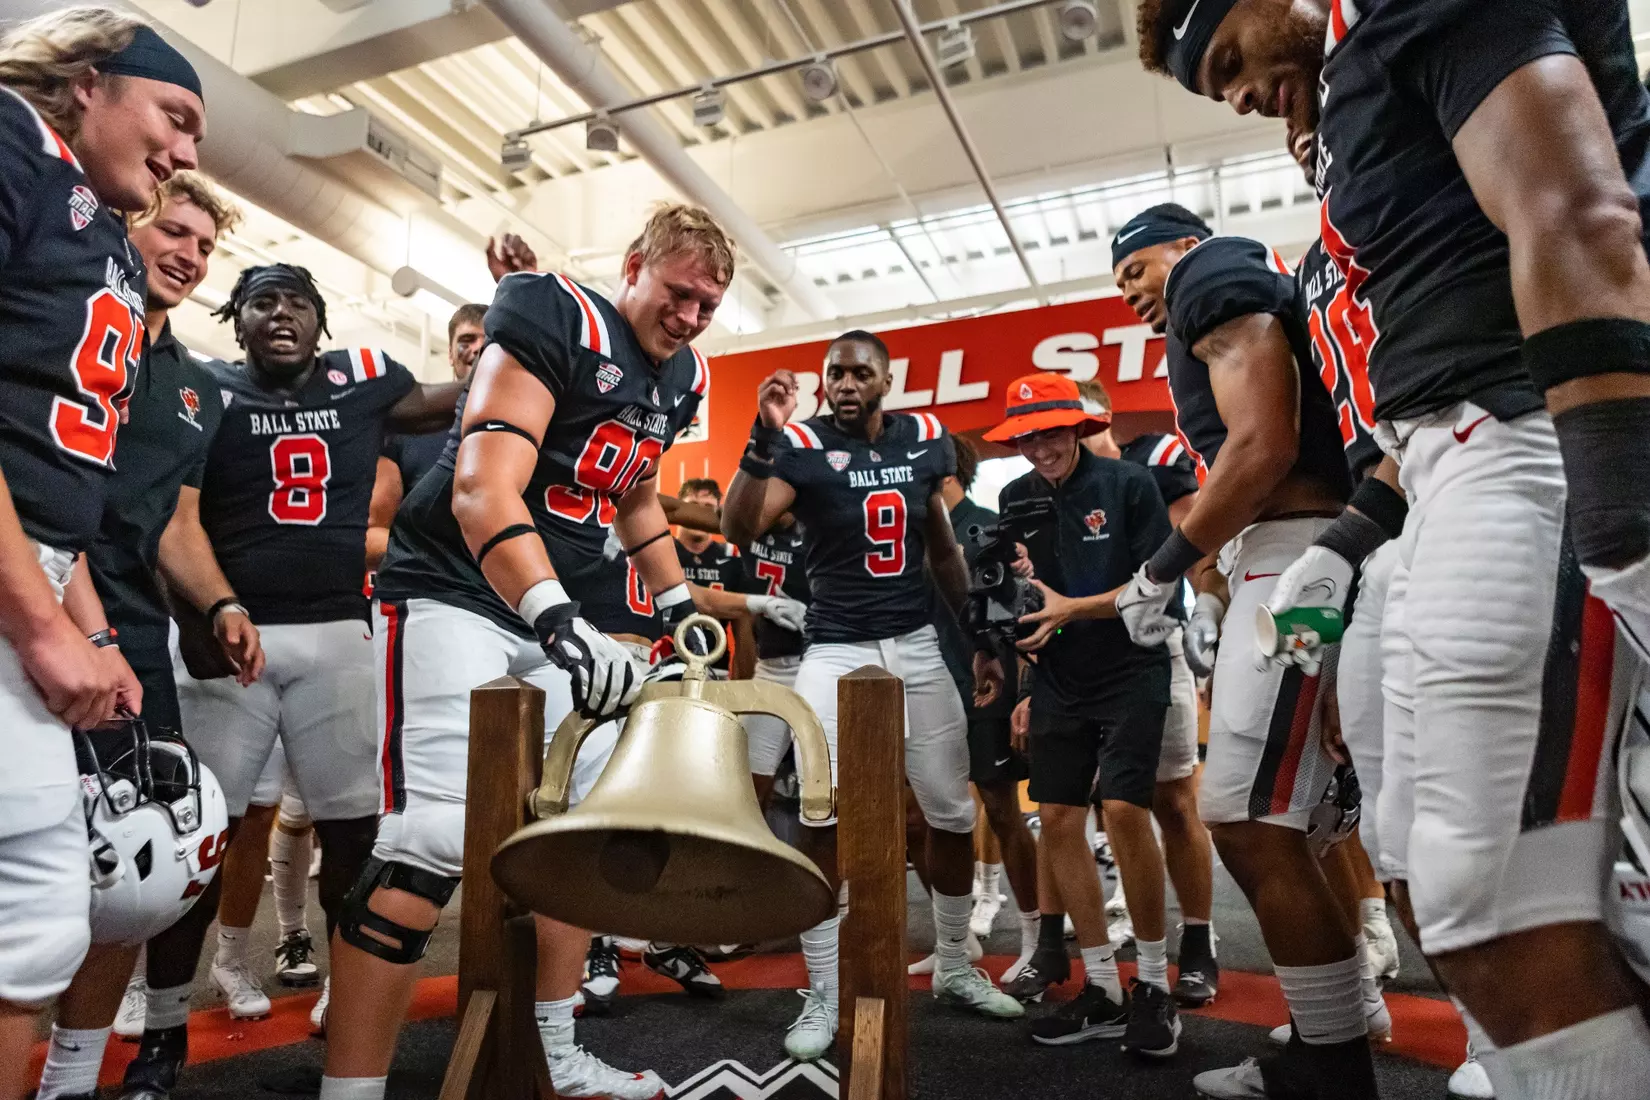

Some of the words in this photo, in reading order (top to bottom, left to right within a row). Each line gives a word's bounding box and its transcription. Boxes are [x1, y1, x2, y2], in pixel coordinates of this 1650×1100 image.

[68, 194, 97, 222] MAC
[596, 368, 621, 387] MAC
[789, 348, 990, 424] BLL
[250, 413, 292, 435] BALL
[297, 409, 341, 434] STATE
[617, 405, 643, 428] BALL
[643, 413, 668, 436] STATE
[268, 433, 332, 526] 8
[849, 470, 879, 488] BALL
[880, 466, 914, 485] STATE
[862, 489, 907, 578] 9
[750, 541, 769, 559] BALL
[770, 548, 793, 565] STATE
[697, 568, 720, 581] STATE
[757, 559, 787, 597] 7
